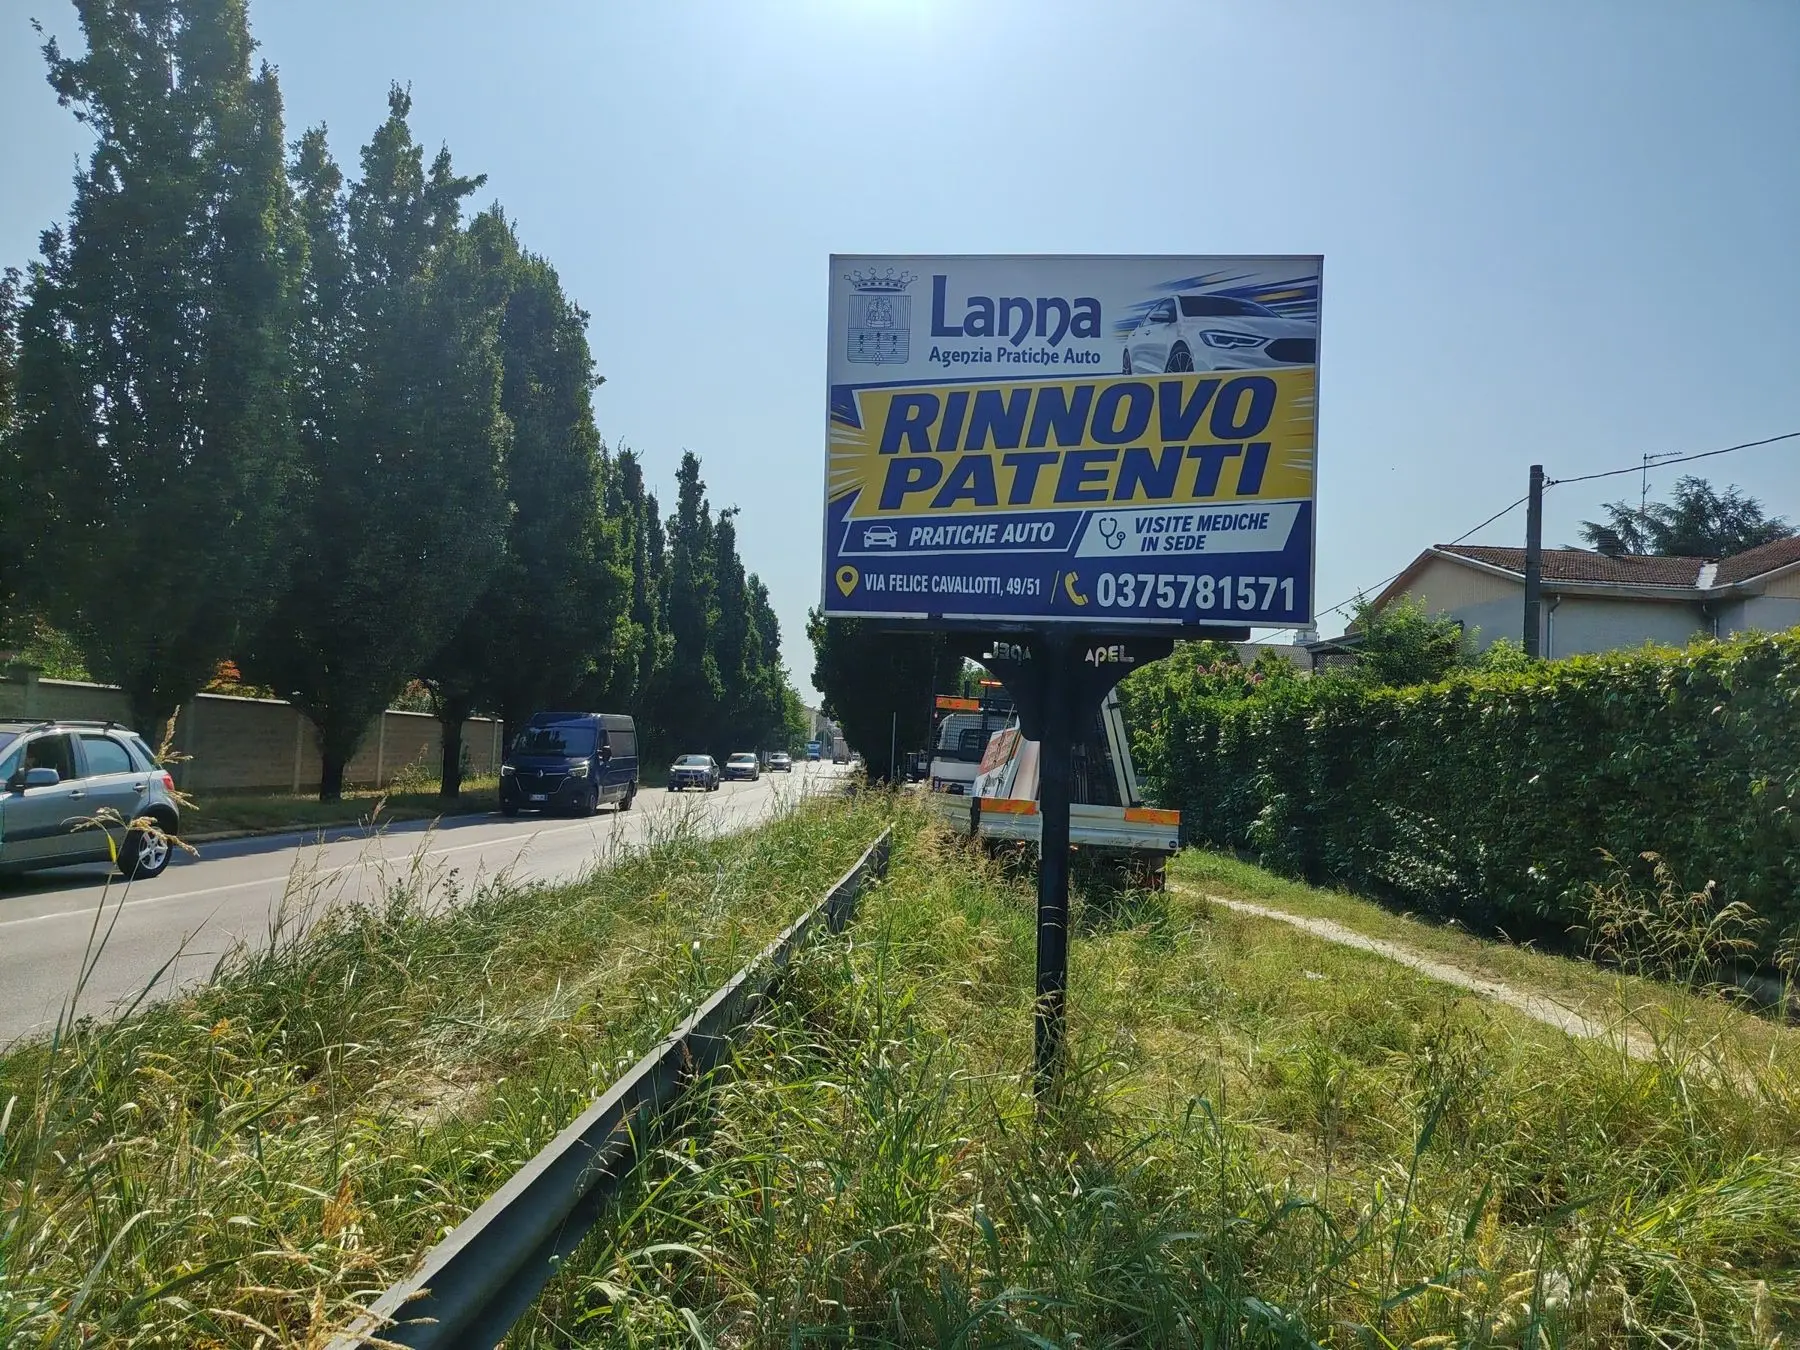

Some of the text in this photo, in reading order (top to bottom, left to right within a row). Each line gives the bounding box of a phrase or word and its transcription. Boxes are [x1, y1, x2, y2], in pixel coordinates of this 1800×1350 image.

[931, 275, 1101, 347] Lanna
[928, 346, 1101, 368] Agenzia Pratiche Auto
[878, 376, 1278, 454] RINNOVO
[878, 442, 1272, 510] PATENTI
[909, 522, 1055, 546] PRATICHE AUTO
[1135, 512, 1270, 534] VISITE MEDICHE
[1140, 535, 1206, 552] IN SEDE
[864, 573, 1040, 596] VIA FELICE CAVALLOTTI, 49/51
[1096, 572, 1294, 611] 0375781571
[1084, 644, 1135, 668] APEL
